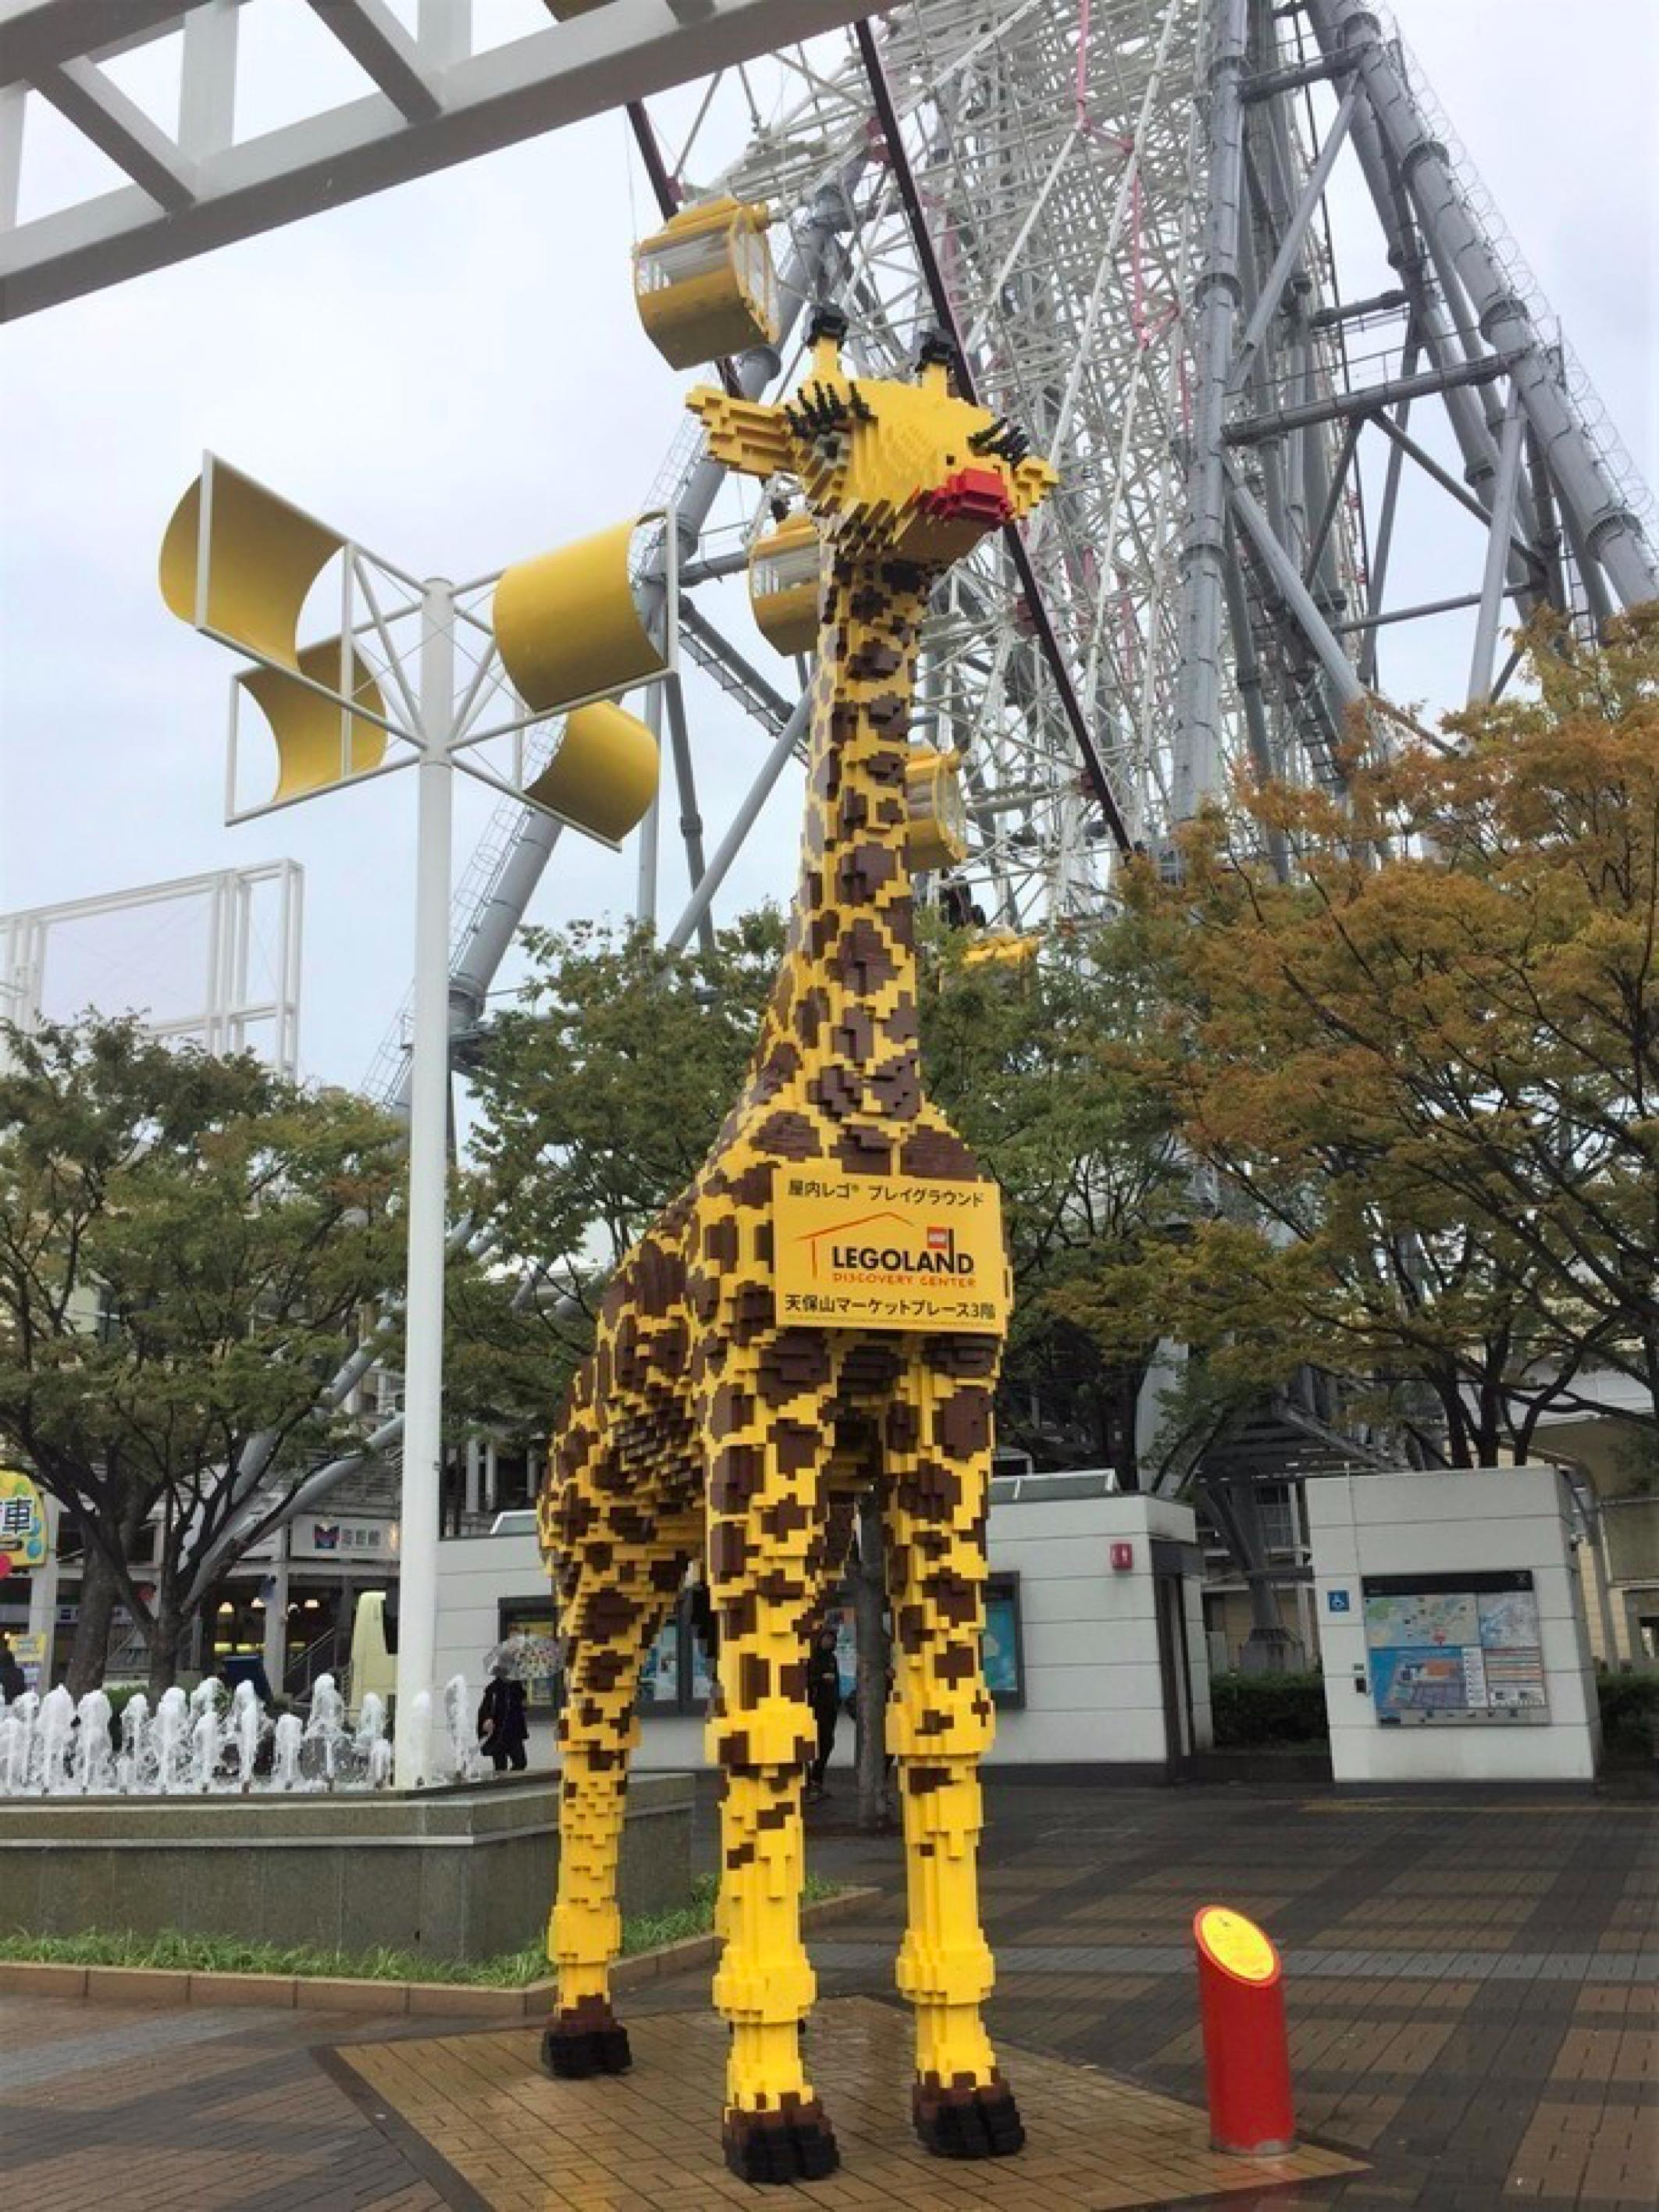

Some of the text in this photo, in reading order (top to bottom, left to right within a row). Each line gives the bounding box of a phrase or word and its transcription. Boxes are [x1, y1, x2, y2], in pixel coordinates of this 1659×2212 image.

[867, 1184, 984, 1208] プレイグラウンド
[832, 1227, 974, 1274] LEGOLAND
[0, 1497, 33, 1534] 車
